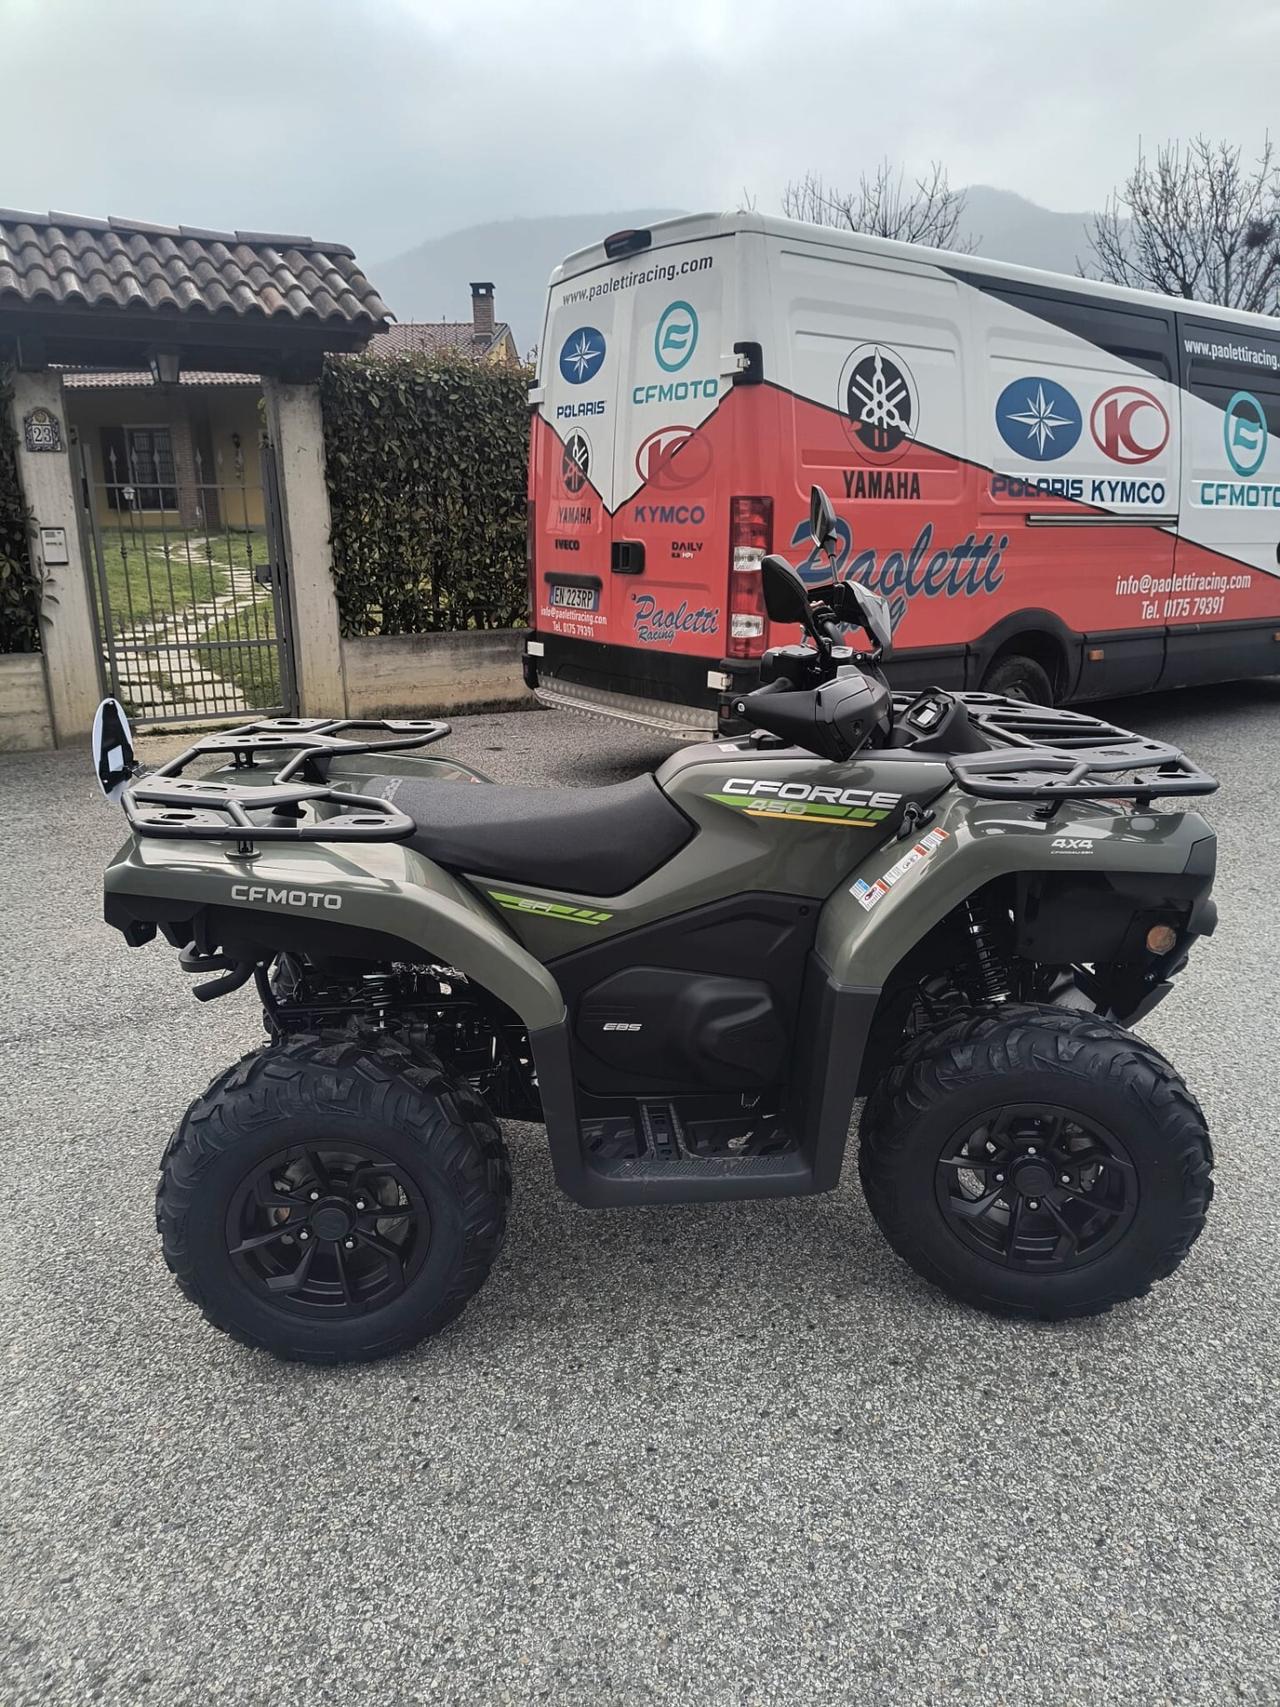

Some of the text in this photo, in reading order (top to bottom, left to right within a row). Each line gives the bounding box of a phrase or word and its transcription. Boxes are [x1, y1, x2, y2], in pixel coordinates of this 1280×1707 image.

[562, 256, 713, 305] www.paolettiracing.com
[633, 379, 718, 404] CFMOTO
[557, 401, 605, 419] POLARIS
[33, 427, 51, 443] 23
[843, 470, 920, 500] YAMAHA
[991, 476, 1083, 499] POLARIS
[1091, 480, 1165, 504] KYMCO
[559, 506, 592, 525] YAMAHA
[634, 505, 705, 525] KYMCO
[555, 539, 580, 551] IVECO
[671, 541, 703, 552] DAILY
[790, 516, 1010, 597] Paoletti
[1116, 572, 1251, 597] info@paolettiracing.com
[555, 587, 593, 608] EN 223RP
[1142, 596, 1225, 619] Tel. 0175 79391
[631, 593, 720, 634] Paoletti
[638, 625, 676, 645] Racing
[722, 778, 902, 809] CFORCE
[748, 800, 806, 815] 450
[231, 885, 342, 910] CFMOTO
[603, 1022, 642, 1031] EBS
